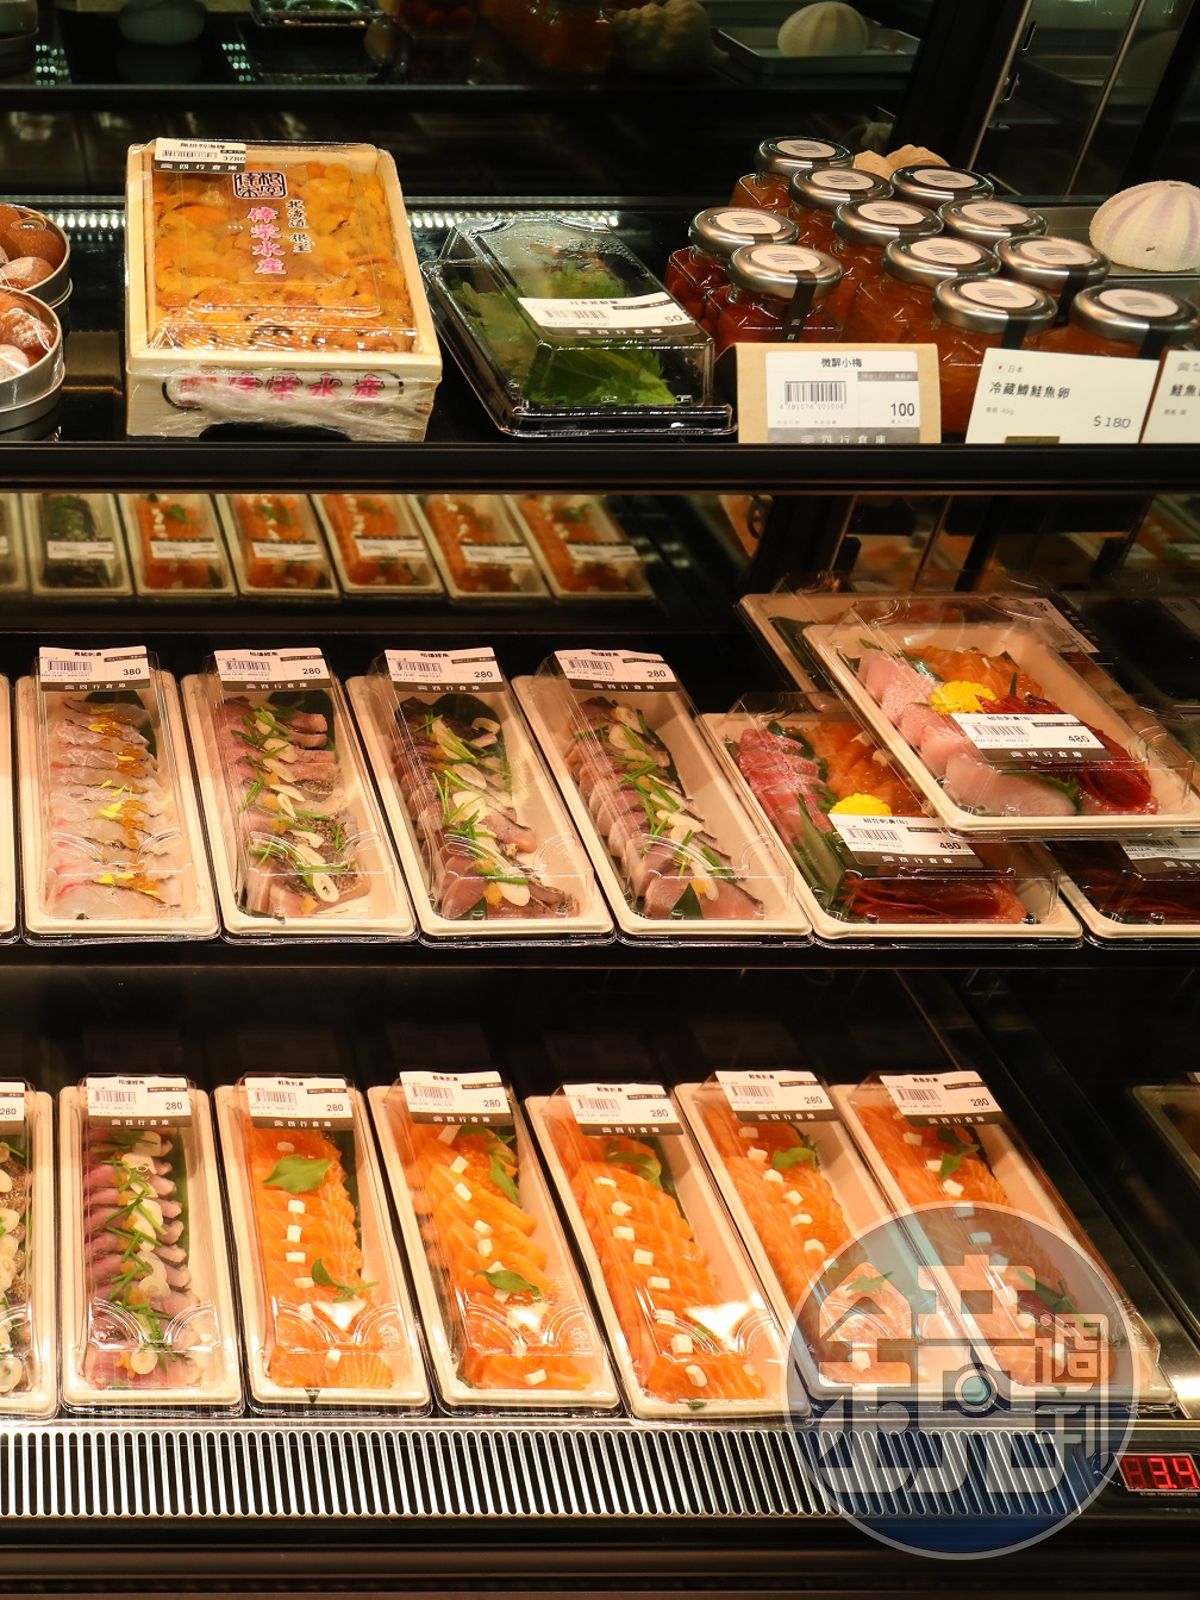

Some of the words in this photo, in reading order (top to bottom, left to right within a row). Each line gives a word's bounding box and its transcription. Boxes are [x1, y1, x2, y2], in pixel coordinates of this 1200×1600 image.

[821, 357, 863, 369] 微醉小梅
[1169, 383, 1200, 398] 鮭魚
[891, 402, 916, 417] 100
[122, 667, 142, 676] 380
[301, 667, 321, 675] 280
[473, 670, 494, 679] 280
[646, 669, 667, 678] 280
[1067, 735, 1090, 743] 480
[939, 841, 962, 850] 480
[482, 1099, 501, 1108] 280
[803, 1095, 823, 1105] 280
[969, 1097, 990, 1107] 280
[165, 1101, 183, 1110] 280
[326, 1103, 344, 1112] 280
[0, 1107, 17, 1115] 280
[649, 1109, 669, 1118] 280
